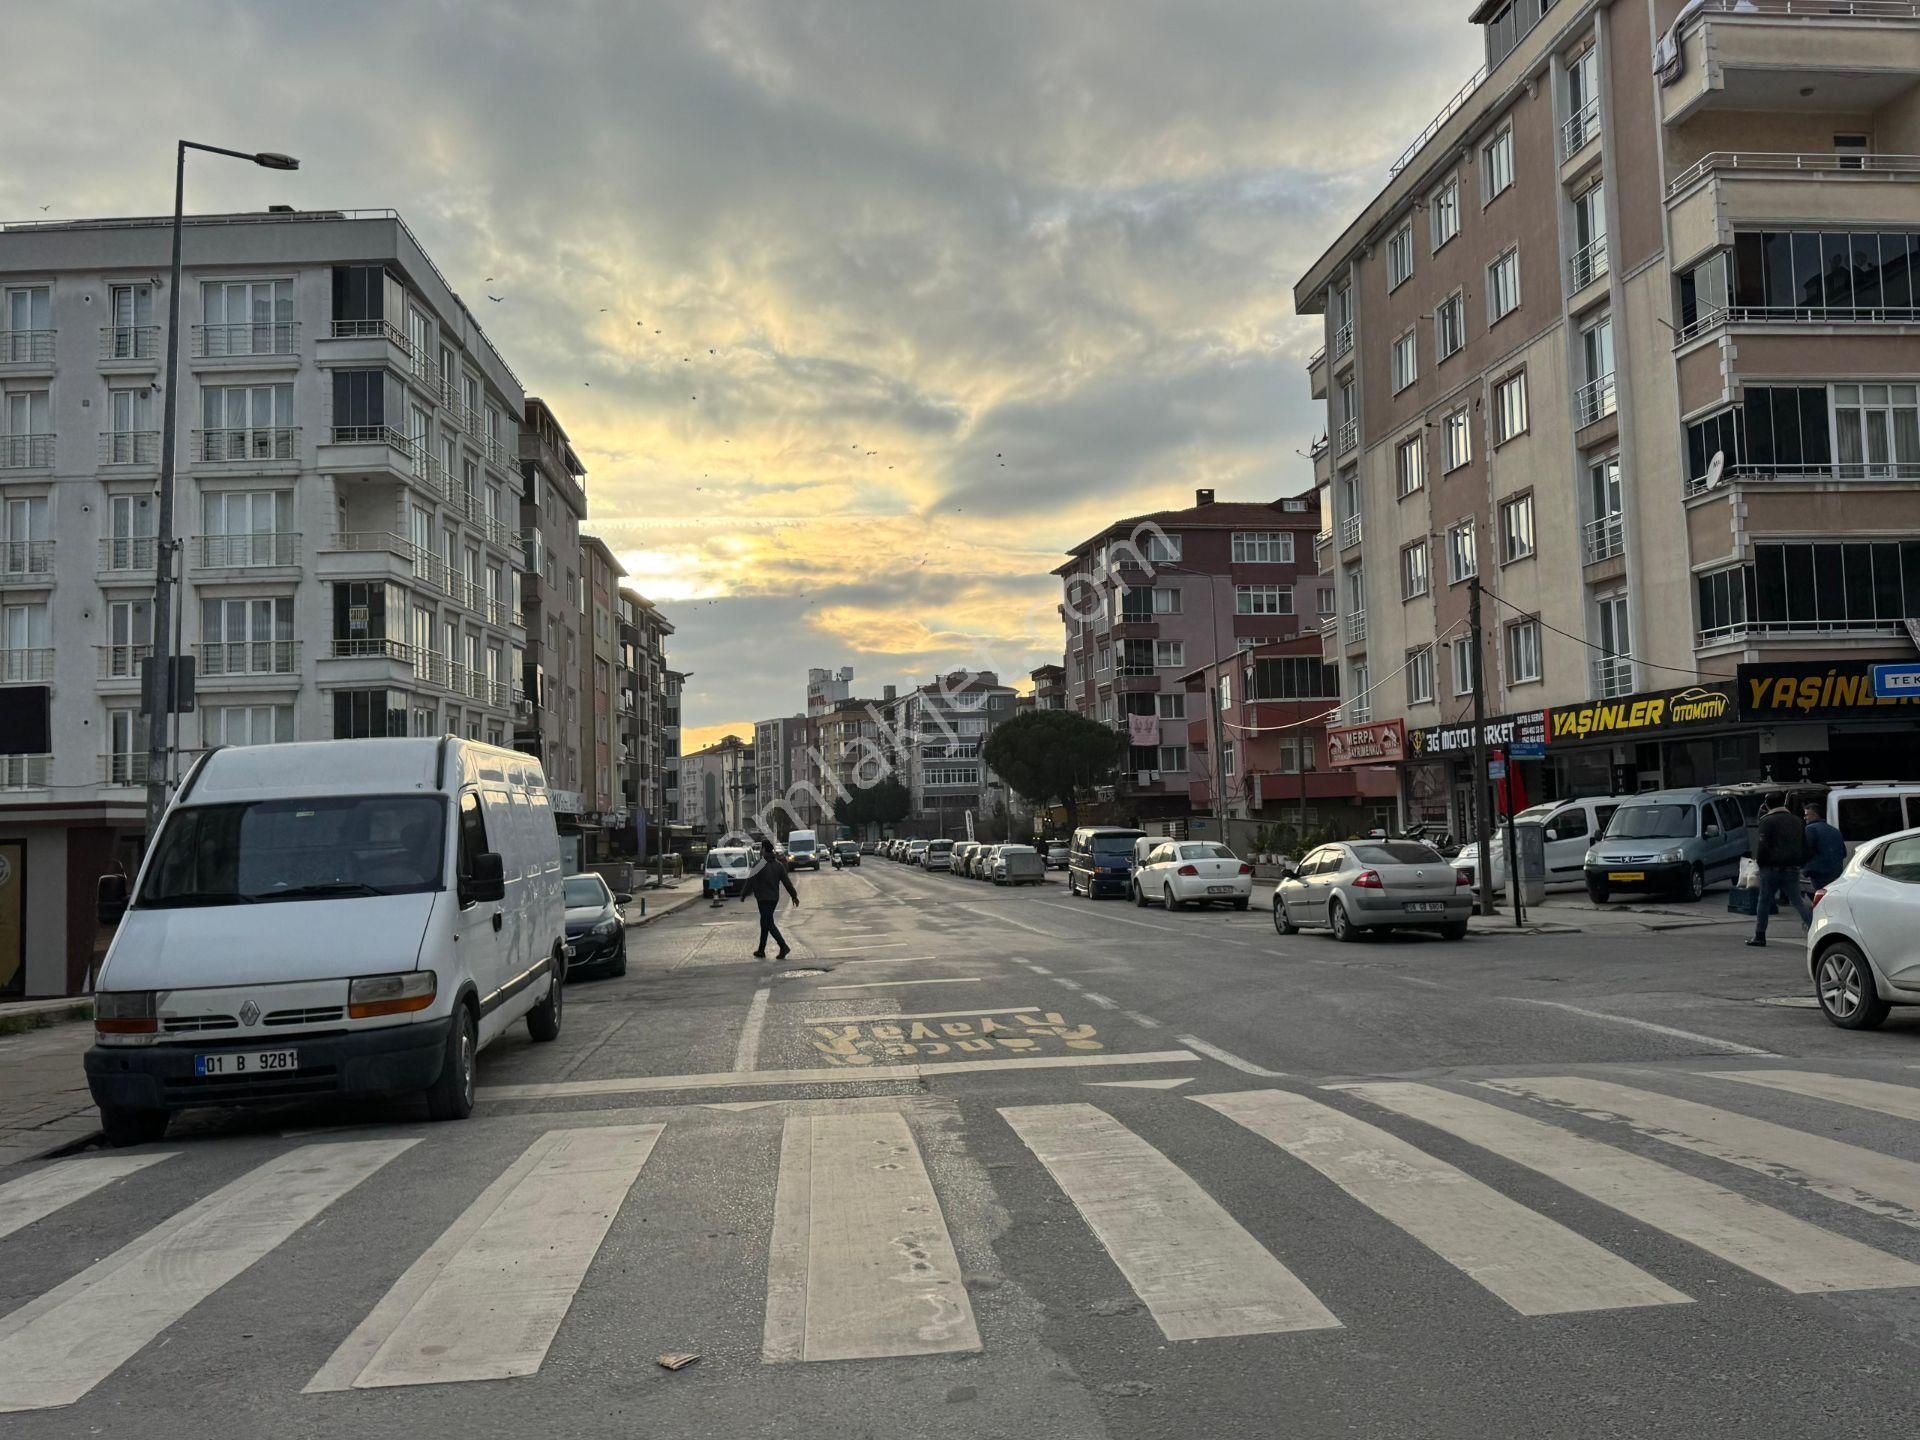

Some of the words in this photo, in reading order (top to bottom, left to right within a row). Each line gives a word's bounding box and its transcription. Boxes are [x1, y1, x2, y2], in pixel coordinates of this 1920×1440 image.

[1749, 668, 1920, 714] YAŞİNL
[1553, 700, 1665, 740] YAŞİNLER
[1672, 697, 1726, 722] OTOMOTİV
[1346, 729, 1375, 745] MERPA
[1441, 732, 1469, 751] MOTO
[206, 1057, 222, 1072] 01
[238, 1055, 245, 1071] B
[260, 1053, 295, 1069] 9281
